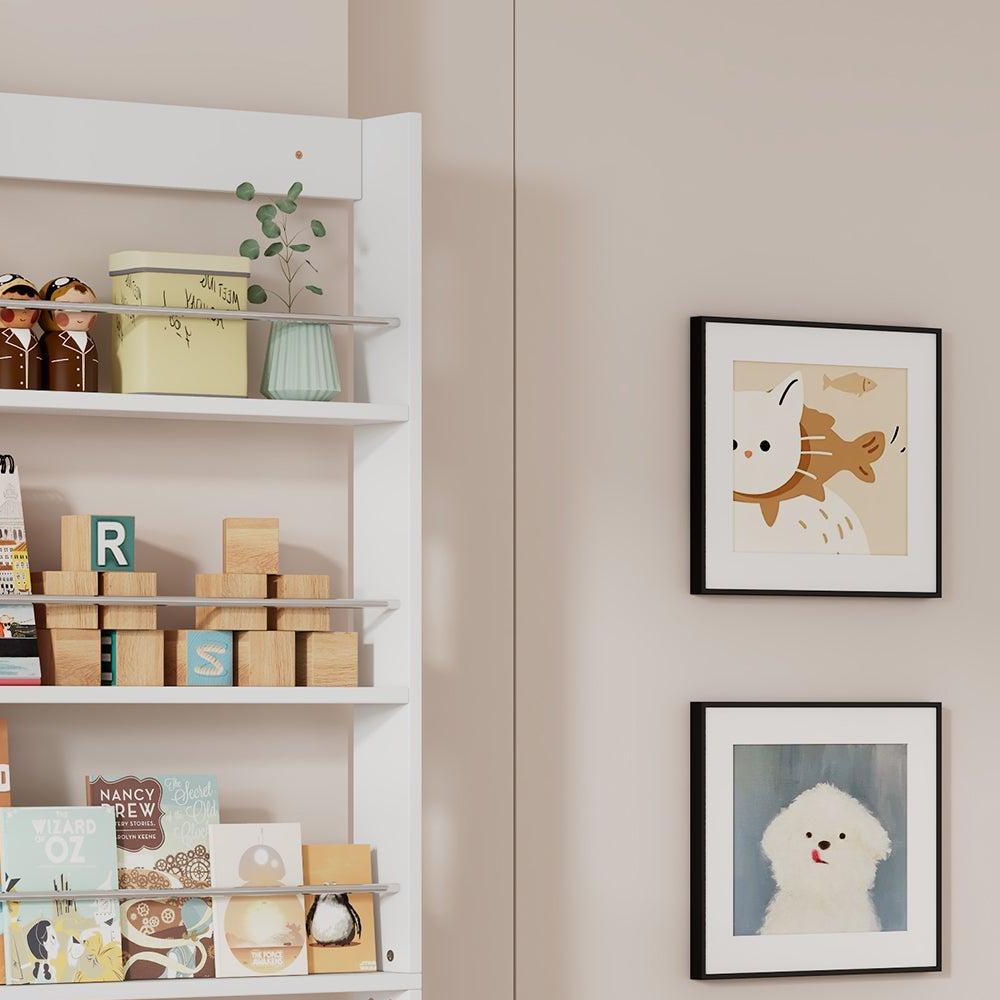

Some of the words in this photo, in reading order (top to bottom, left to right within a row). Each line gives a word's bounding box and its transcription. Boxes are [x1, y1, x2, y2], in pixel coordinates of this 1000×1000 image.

[97, 521, 128, 566] R
[193, 643, 226, 676] S
[100, 788, 155, 801] NANCY
[171, 780, 212, 806] Secret
[101, 803, 156, 818] REW
[31, 818, 97, 835] WIZARD
[45, 835, 87, 864] OZ
